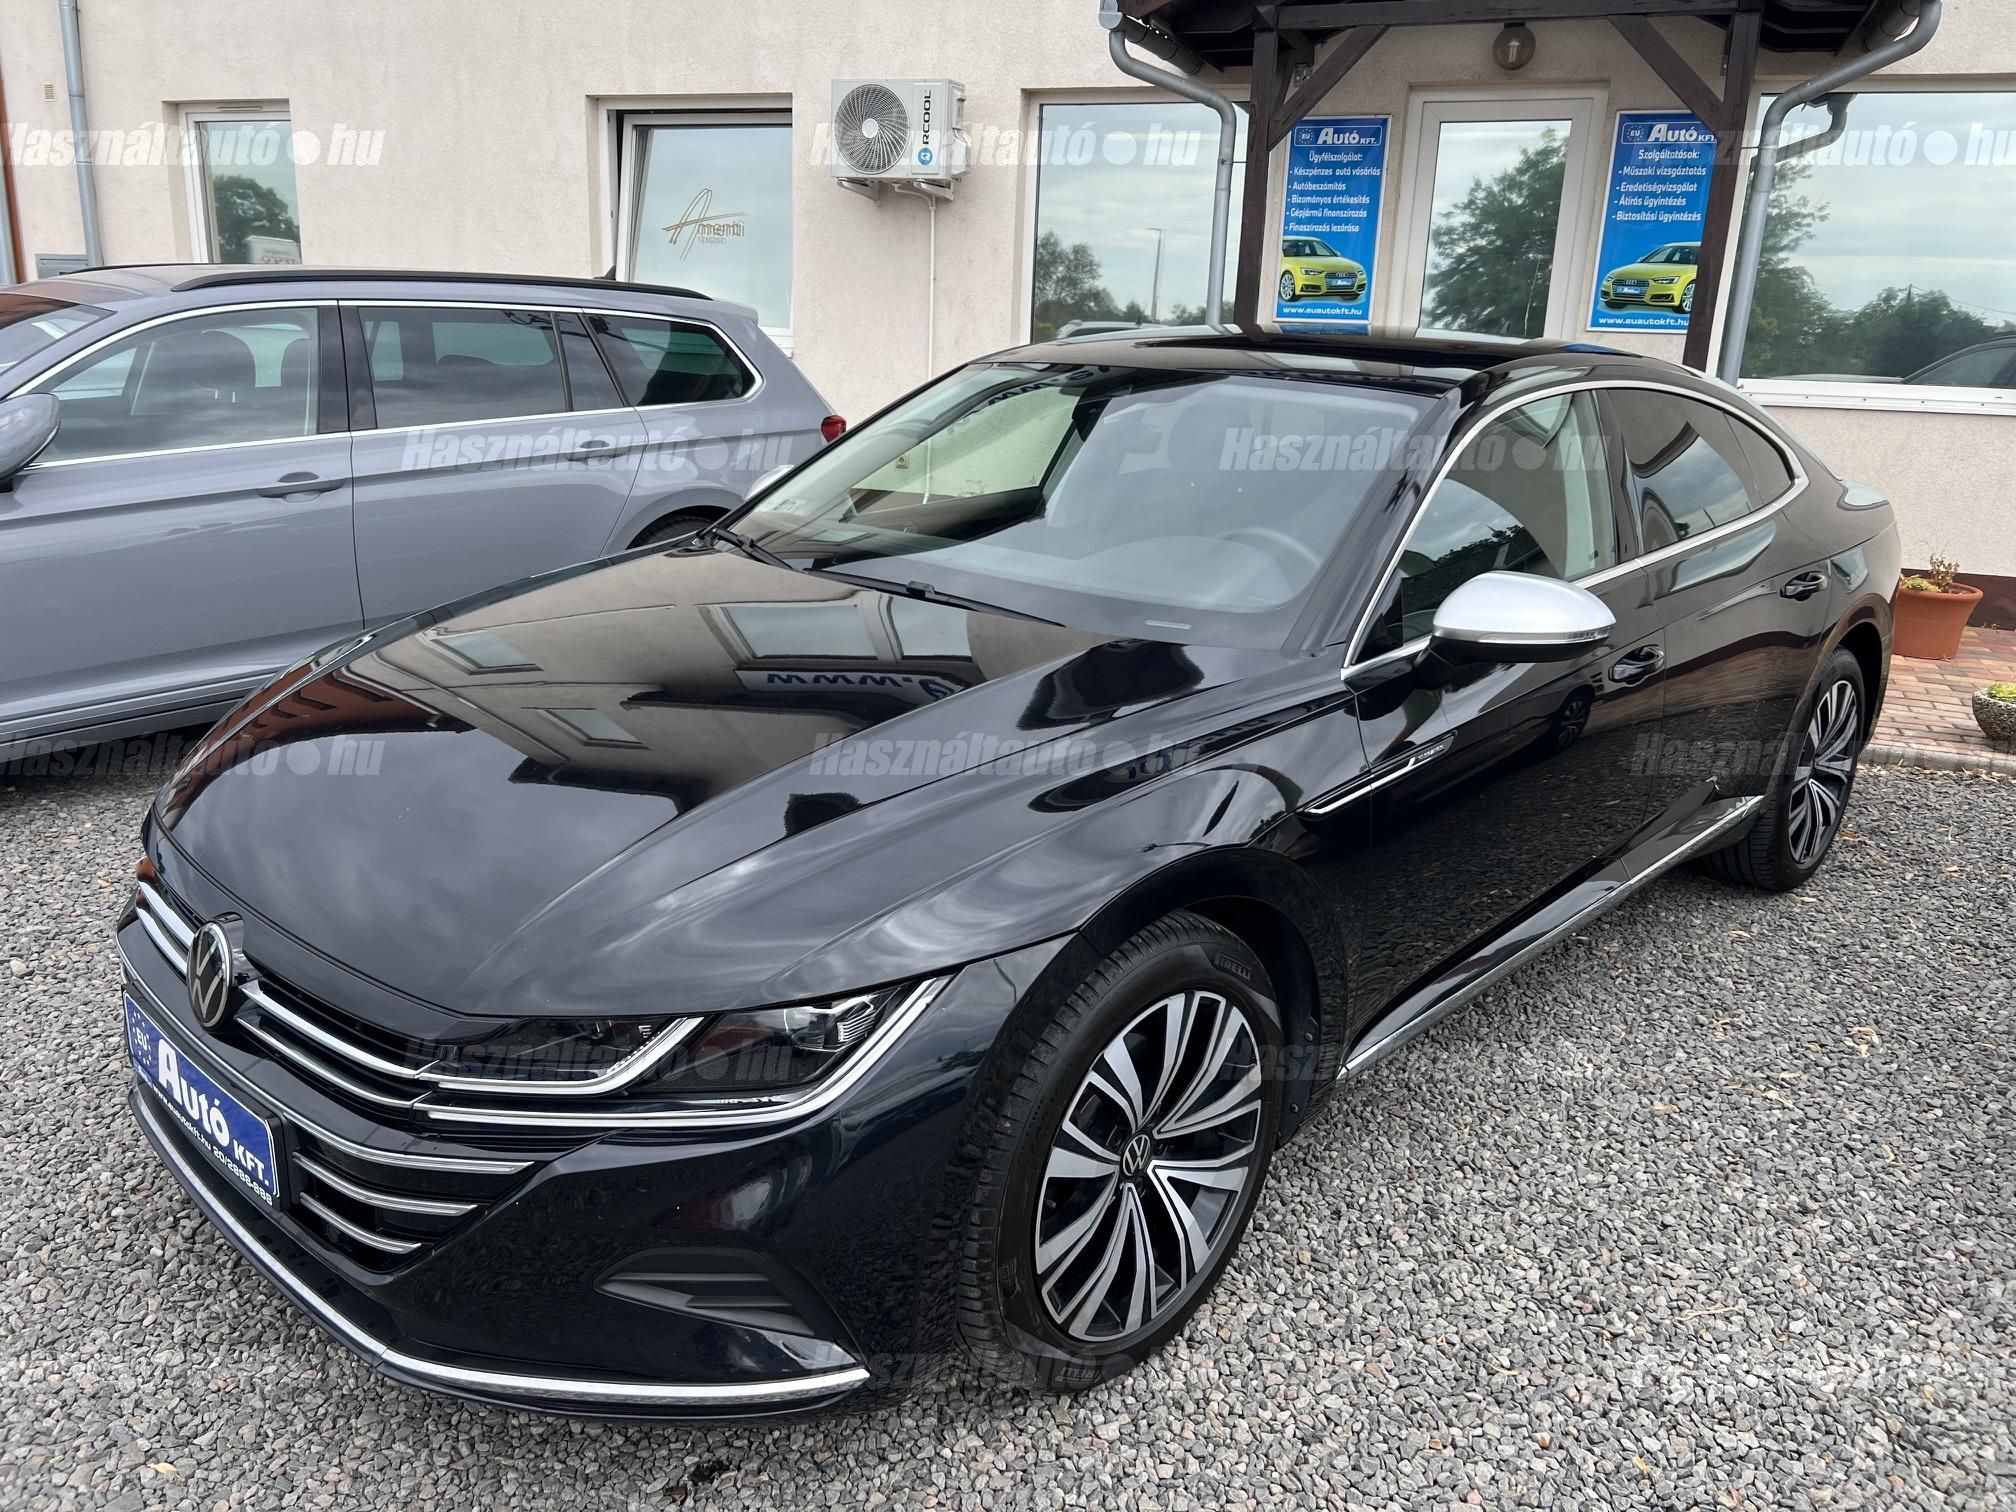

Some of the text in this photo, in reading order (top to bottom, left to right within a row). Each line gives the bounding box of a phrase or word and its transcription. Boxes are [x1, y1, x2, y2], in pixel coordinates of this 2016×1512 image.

[1317, 128, 1360, 144] Autó
[1648, 123, 1698, 142] Autó
[1309, 150, 1364, 163] Ügyfélszolgálat:
[1638, 148, 1701, 161] Szolgáltatások:
[1335, 166, 1351, 175] autó
[1282, 307, 1363, 315] www.euautokft.hu
[136, 1026, 270, 1187] EU Autó KFT.
